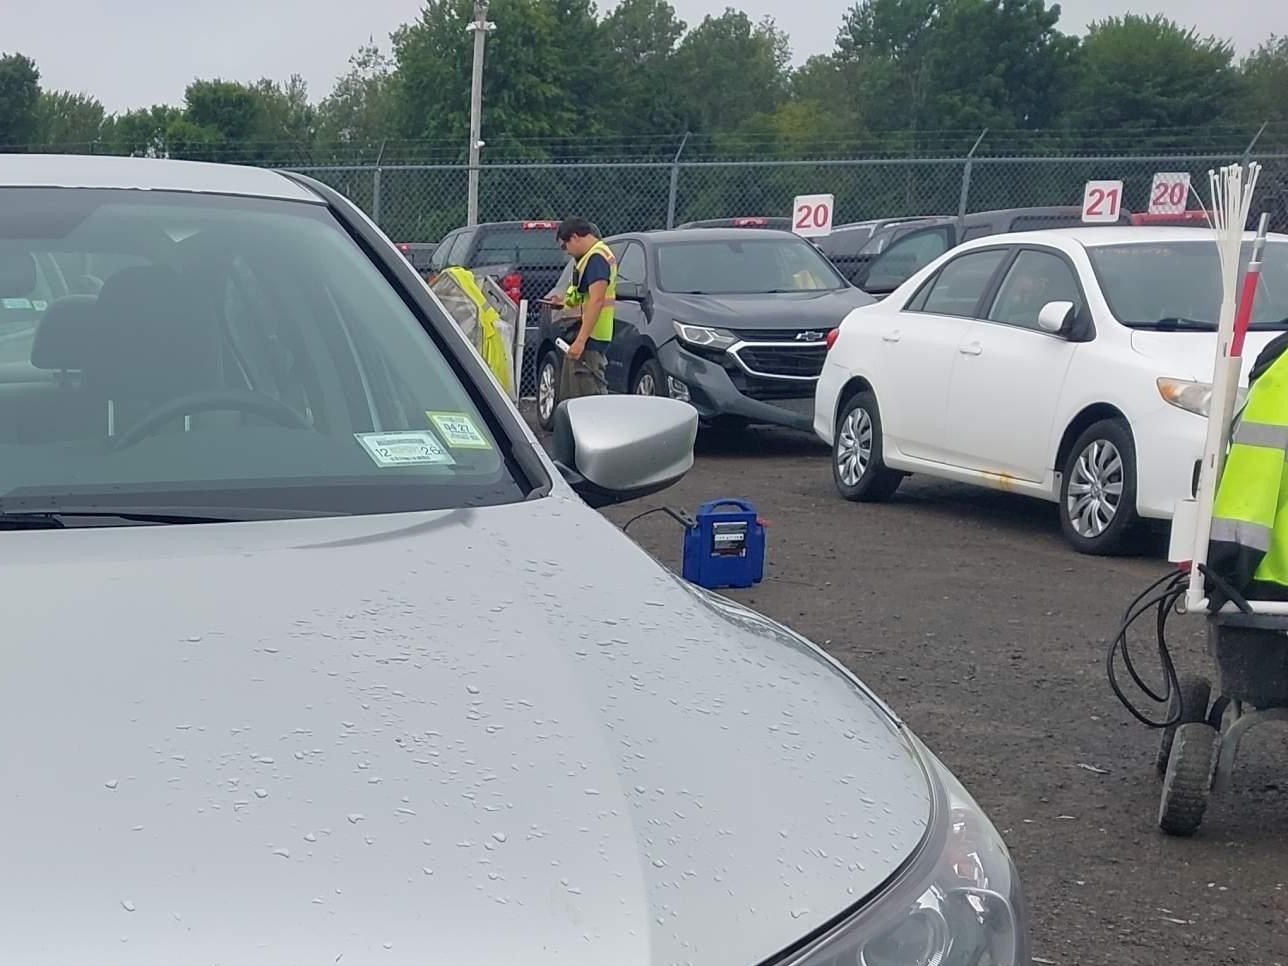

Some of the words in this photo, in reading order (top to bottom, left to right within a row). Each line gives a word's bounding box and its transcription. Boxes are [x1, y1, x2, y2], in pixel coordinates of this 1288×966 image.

[1086, 188, 1119, 216] 21
[1152, 182, 1185, 206] 20
[796, 204, 829, 228] 20
